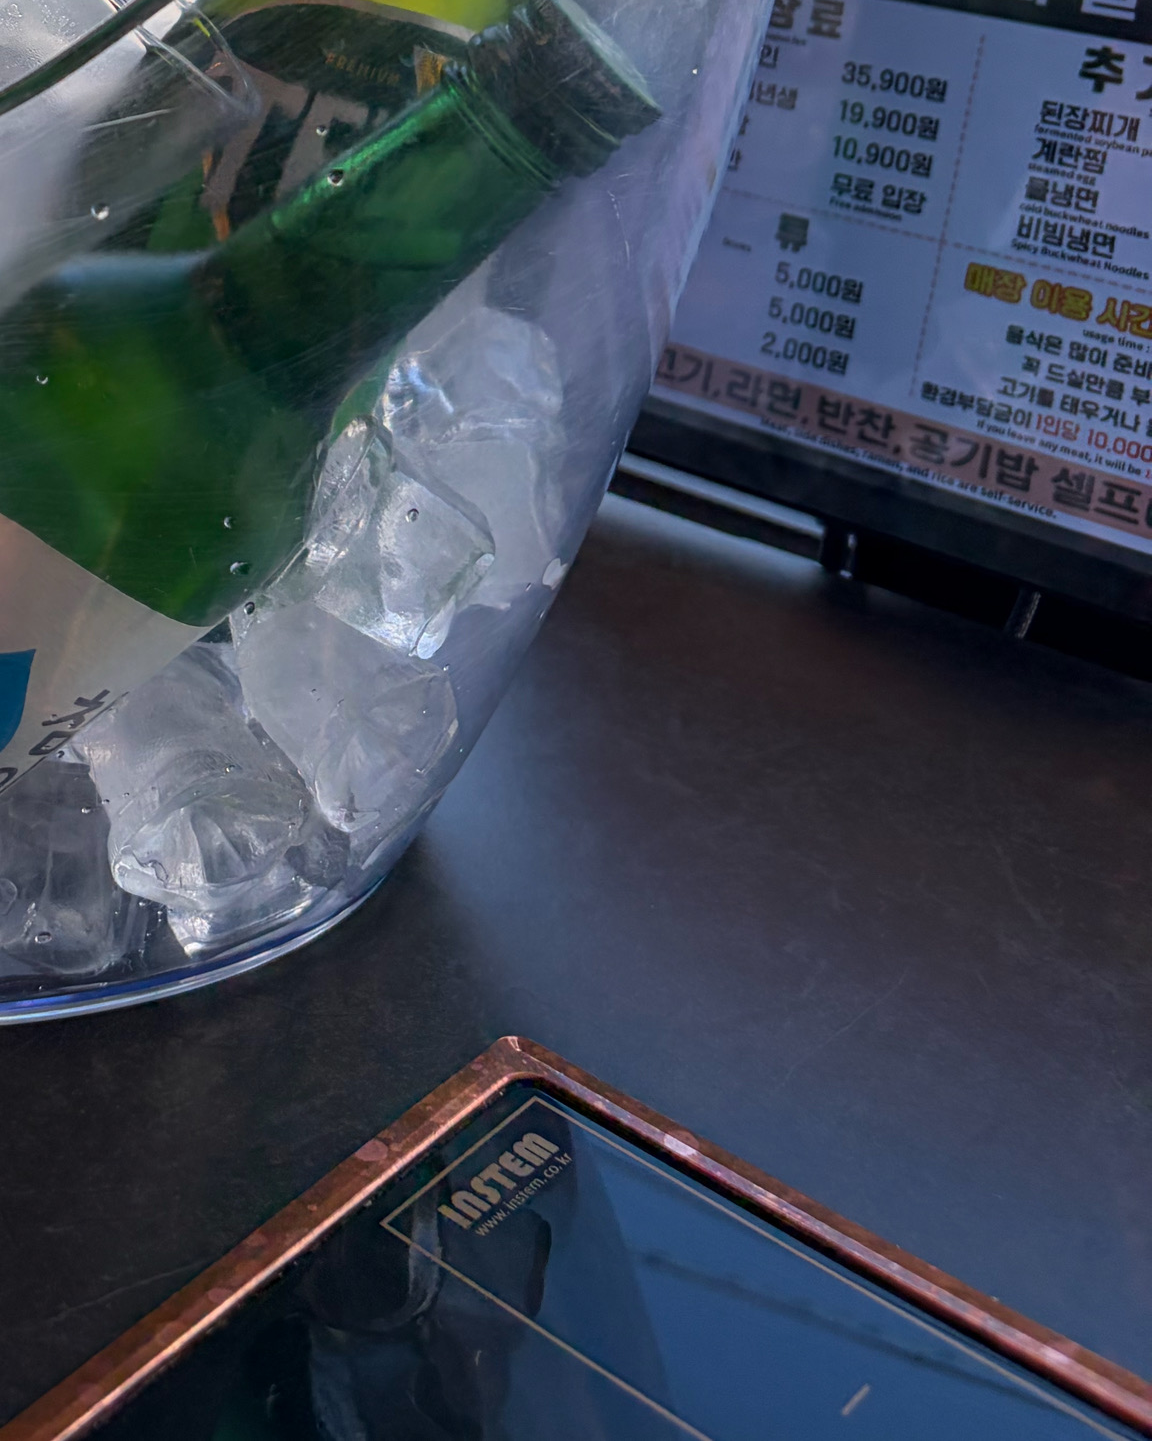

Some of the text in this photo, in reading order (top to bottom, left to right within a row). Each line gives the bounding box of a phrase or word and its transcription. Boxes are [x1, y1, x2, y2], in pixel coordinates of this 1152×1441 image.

[749, 79, 798, 111] 년생
[841, 60, 949, 103] 35,900원
[839, 99, 941, 142] 19,900원
[1034, 123, 1093, 144] fermented
[1094, 135, 1140, 154] soybean
[1040, 99, 1141, 143] 된장찌개
[832, 134, 935, 179] 10,900원
[1027, 162, 1097, 187] steamed egg
[1031, 136, 1109, 176] 계란찜
[830, 171, 928, 216] 무료 입장
[1016, 214, 1117, 260] 비빔냉면
[1019, 202, 1150, 240] cold buckwheat noodles
[1011, 237, 1150, 280] Spicy Buckwheat Noodles
[774, 261, 864, 304] 5,000원
[963, 262, 1028, 304] 매장
[1030, 278, 1093, 322] 이용
[767, 296, 858, 340] 5,000원
[1082, 328, 1115, 345] usage
[1118, 336, 1144, 351] time
[760, 331, 850, 376] 2,000원
[1005, 323, 1063, 356] 음식은
[1068, 340, 1109, 368] 많이
[1046, 362, 1126, 401] 드실만큼
[920, 380, 1033, 429] 환경부담금이
[1035, 413, 1081, 442] 1인당
[996, 375, 1055, 409] 고기를
[1060, 392, 1141, 434] 태우거나
[1007, 426, 1037, 445] leave
[1038, 438, 1059, 453] any
[1094, 452, 1104, 465] it
[1105, 458, 1127, 472] will
[1128, 463, 1142, 476] be
[905, 463, 930, 479] and
[931, 470, 955, 486] rice
[957, 478, 979, 493] are
[1050, 466, 1152, 528] 셀프
[437, 1132, 560, 1229] INSTEM
[475, 1152, 574, 1237] www.instem.co.kr
